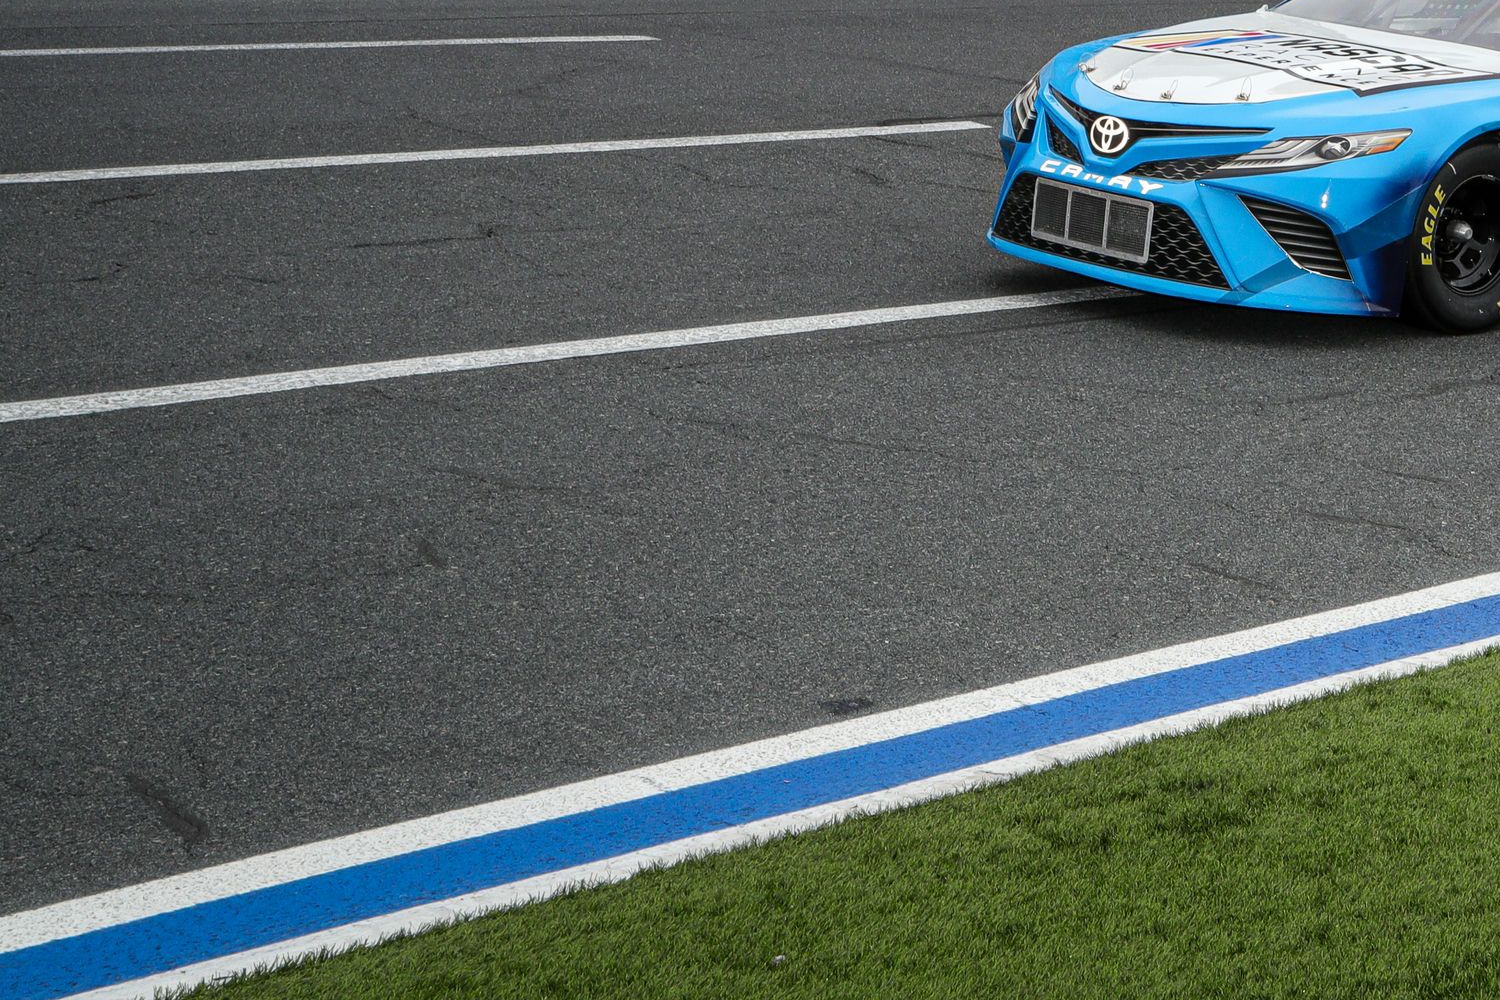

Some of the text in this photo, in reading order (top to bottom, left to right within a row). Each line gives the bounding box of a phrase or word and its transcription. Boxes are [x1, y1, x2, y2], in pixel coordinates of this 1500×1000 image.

[1203, 47, 1379, 85] EXPERIENCE
[1264, 38, 1466, 77] NASCAR
[1421, 184, 1446, 265] EAGLE
